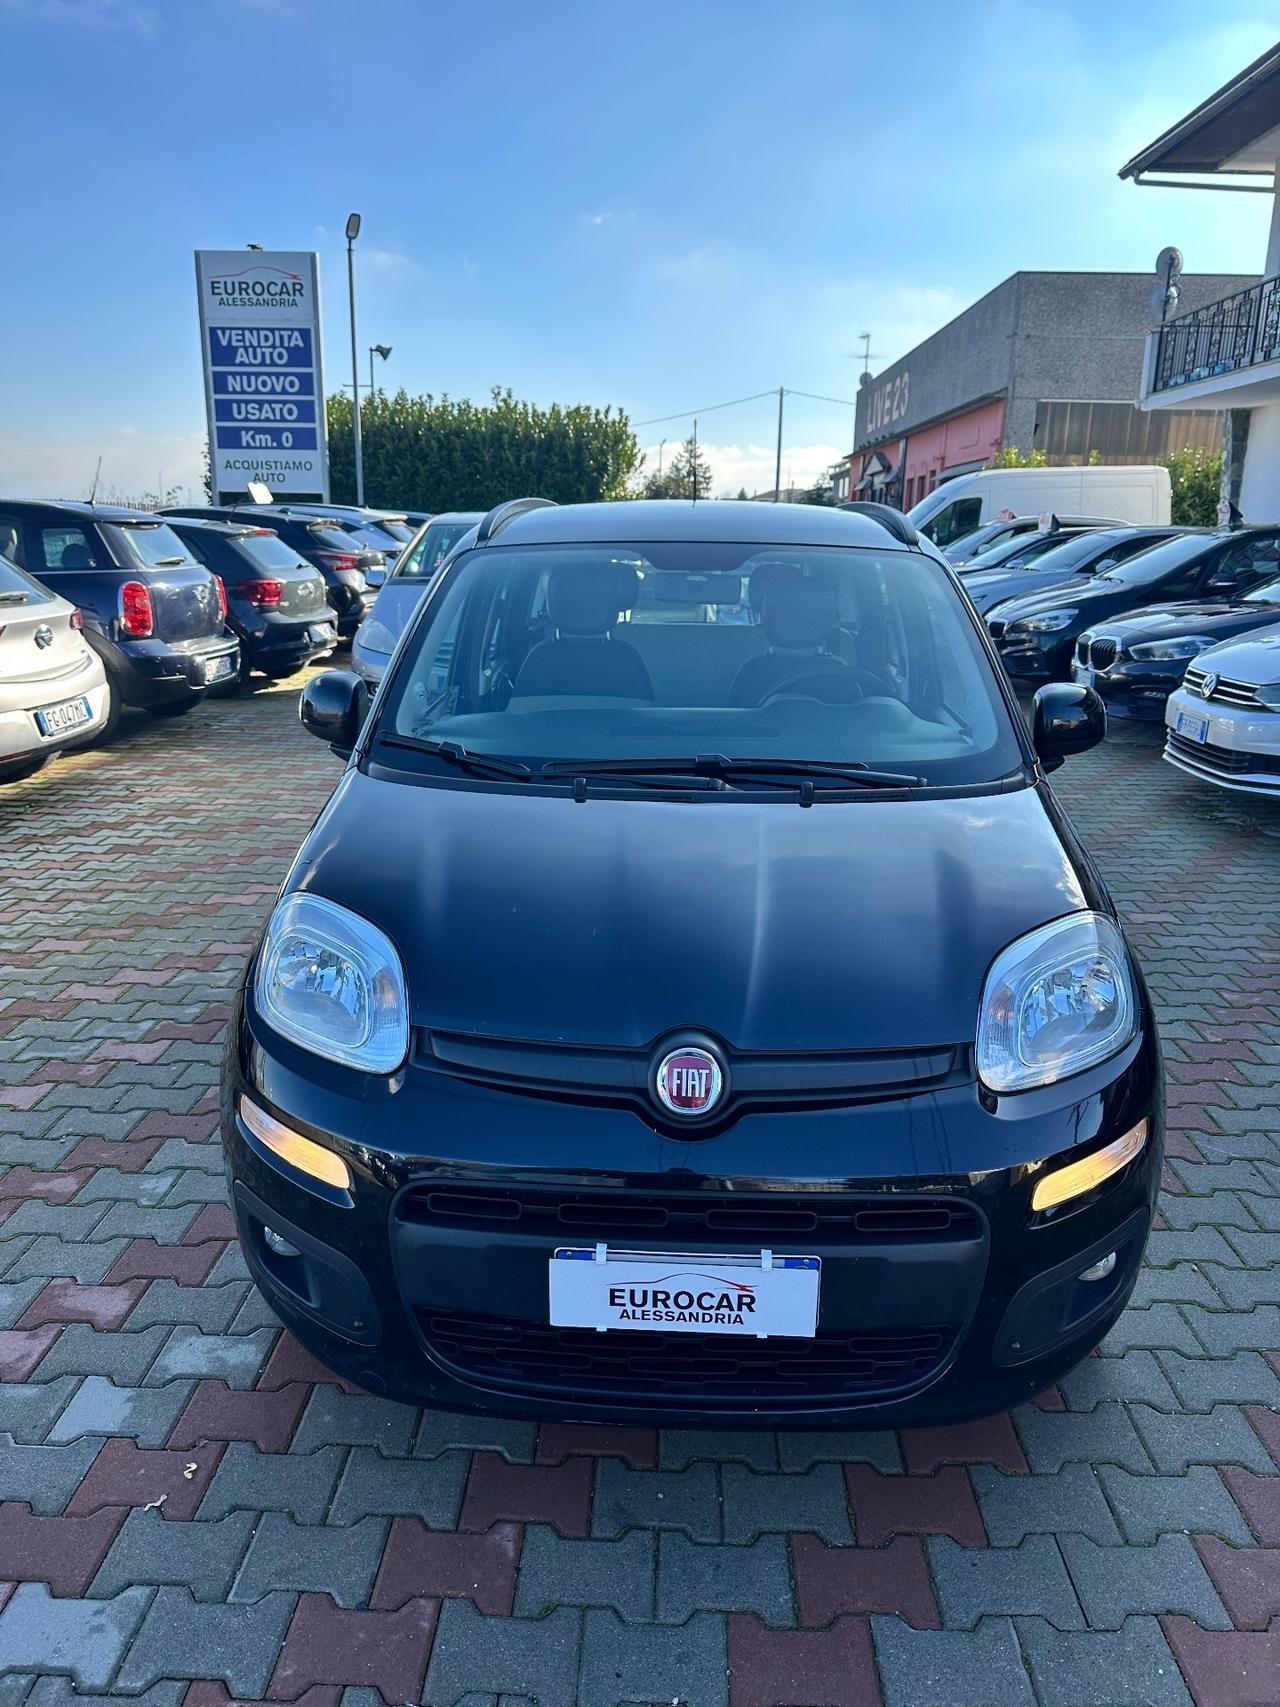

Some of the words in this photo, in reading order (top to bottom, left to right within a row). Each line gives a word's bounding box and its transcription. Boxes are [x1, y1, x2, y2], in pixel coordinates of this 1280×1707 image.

[210, 280, 304, 297] EUROCAR
[218, 297, 298, 307] ALESSANDRIA
[216, 329, 304, 347] VENDITA
[234, 348, 289, 365] AUTO
[227, 375, 300, 393] NUOVO
[232, 403, 298, 420] USATO
[240, 430, 277, 447] Km.
[281, 431, 293, 447] 0
[224, 460, 313, 471] ACQUISTIAMO
[253, 473, 286, 482] AUTO
[672, 1068, 709, 1097] FIAT
[609, 1288, 756, 1312] EUROCAR
[619, 1309, 744, 1324] ALESSANDRIA
